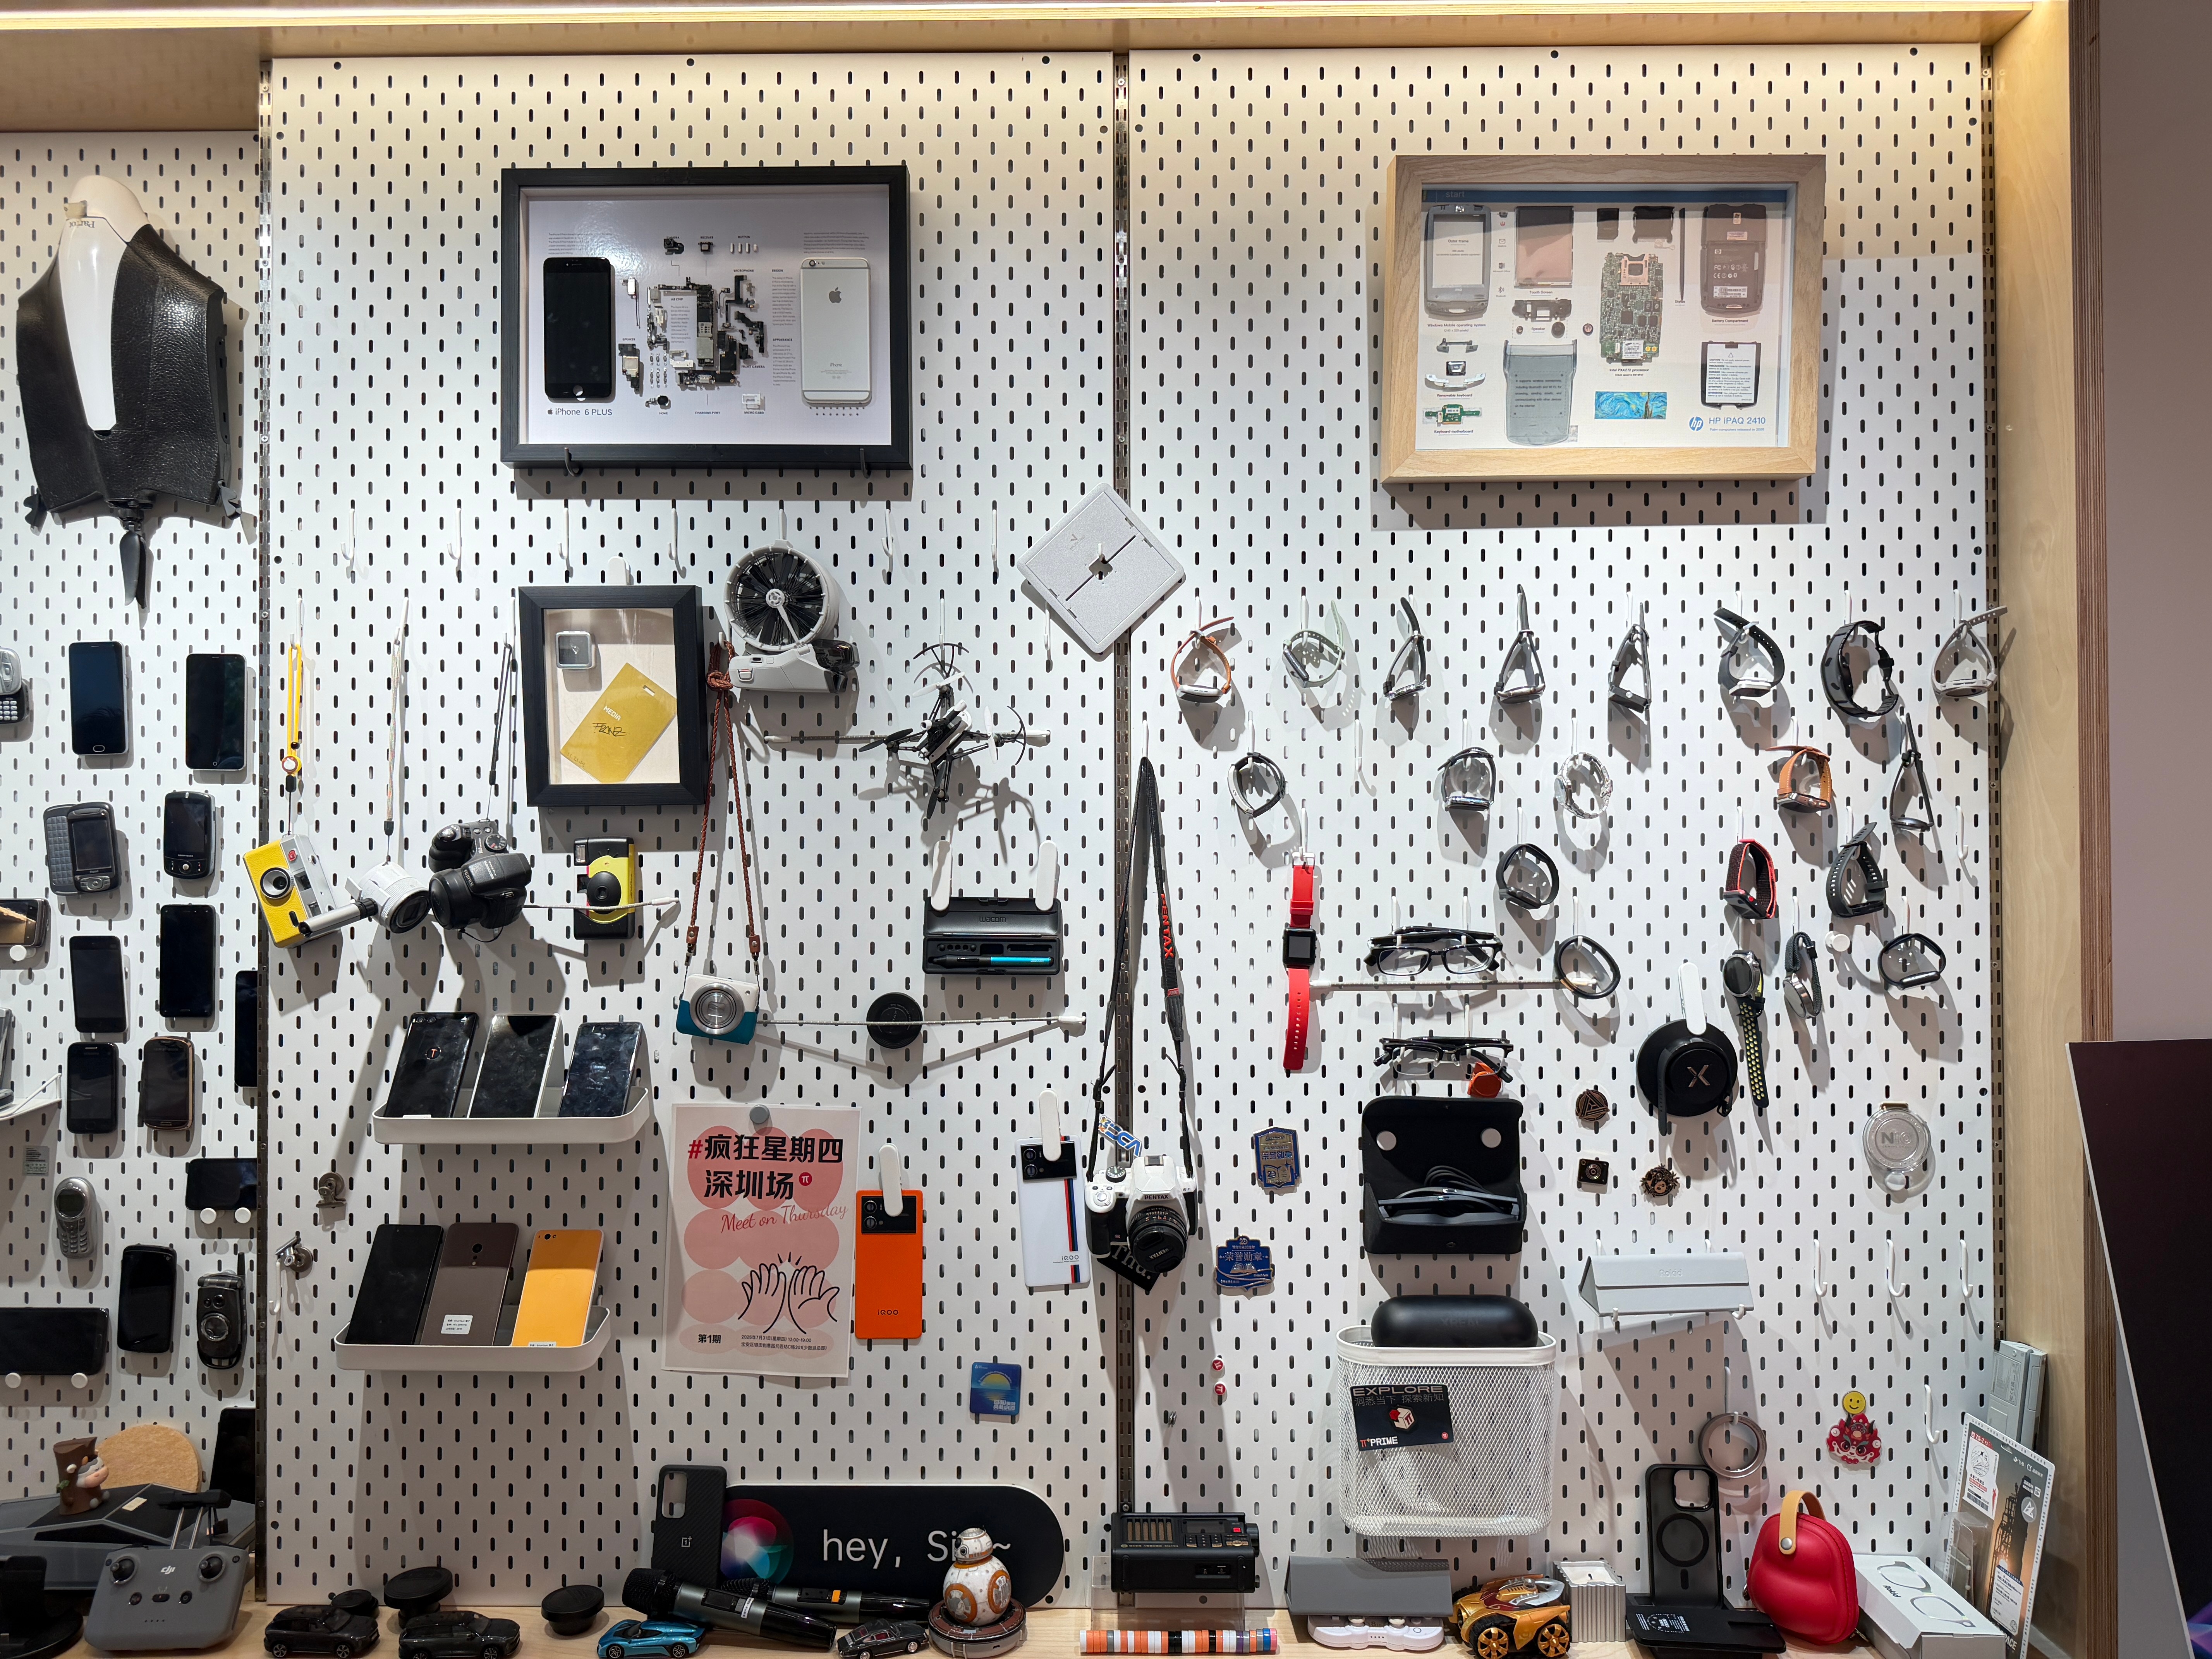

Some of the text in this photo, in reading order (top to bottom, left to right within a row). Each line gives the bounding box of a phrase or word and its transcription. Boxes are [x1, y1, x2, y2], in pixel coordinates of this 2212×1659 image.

[1446, 190, 1465, 198] start
[603, 706, 621, 721] MEDIA
[688, 1134, 843, 1163] #疯狂星期四
[704, 1170, 794, 1200] 深圳场
[721, 1204, 848, 1233] Meet on Thursday
[1111, 1245, 1151, 1280] Thu.
[1224, 1251, 1262, 1262] 荣誉勋章
[698, 1333, 721, 1344] 第1期
[1353, 1386, 1444, 1396] EXPLORE
[1355, 1393, 1444, 1407] 洞悉当下 探索新知
[1370, 1436, 1398, 1447] PRIME
[823, 1529, 901, 1570] hey,
[1882, 1585, 1902, 1597] Rokid
